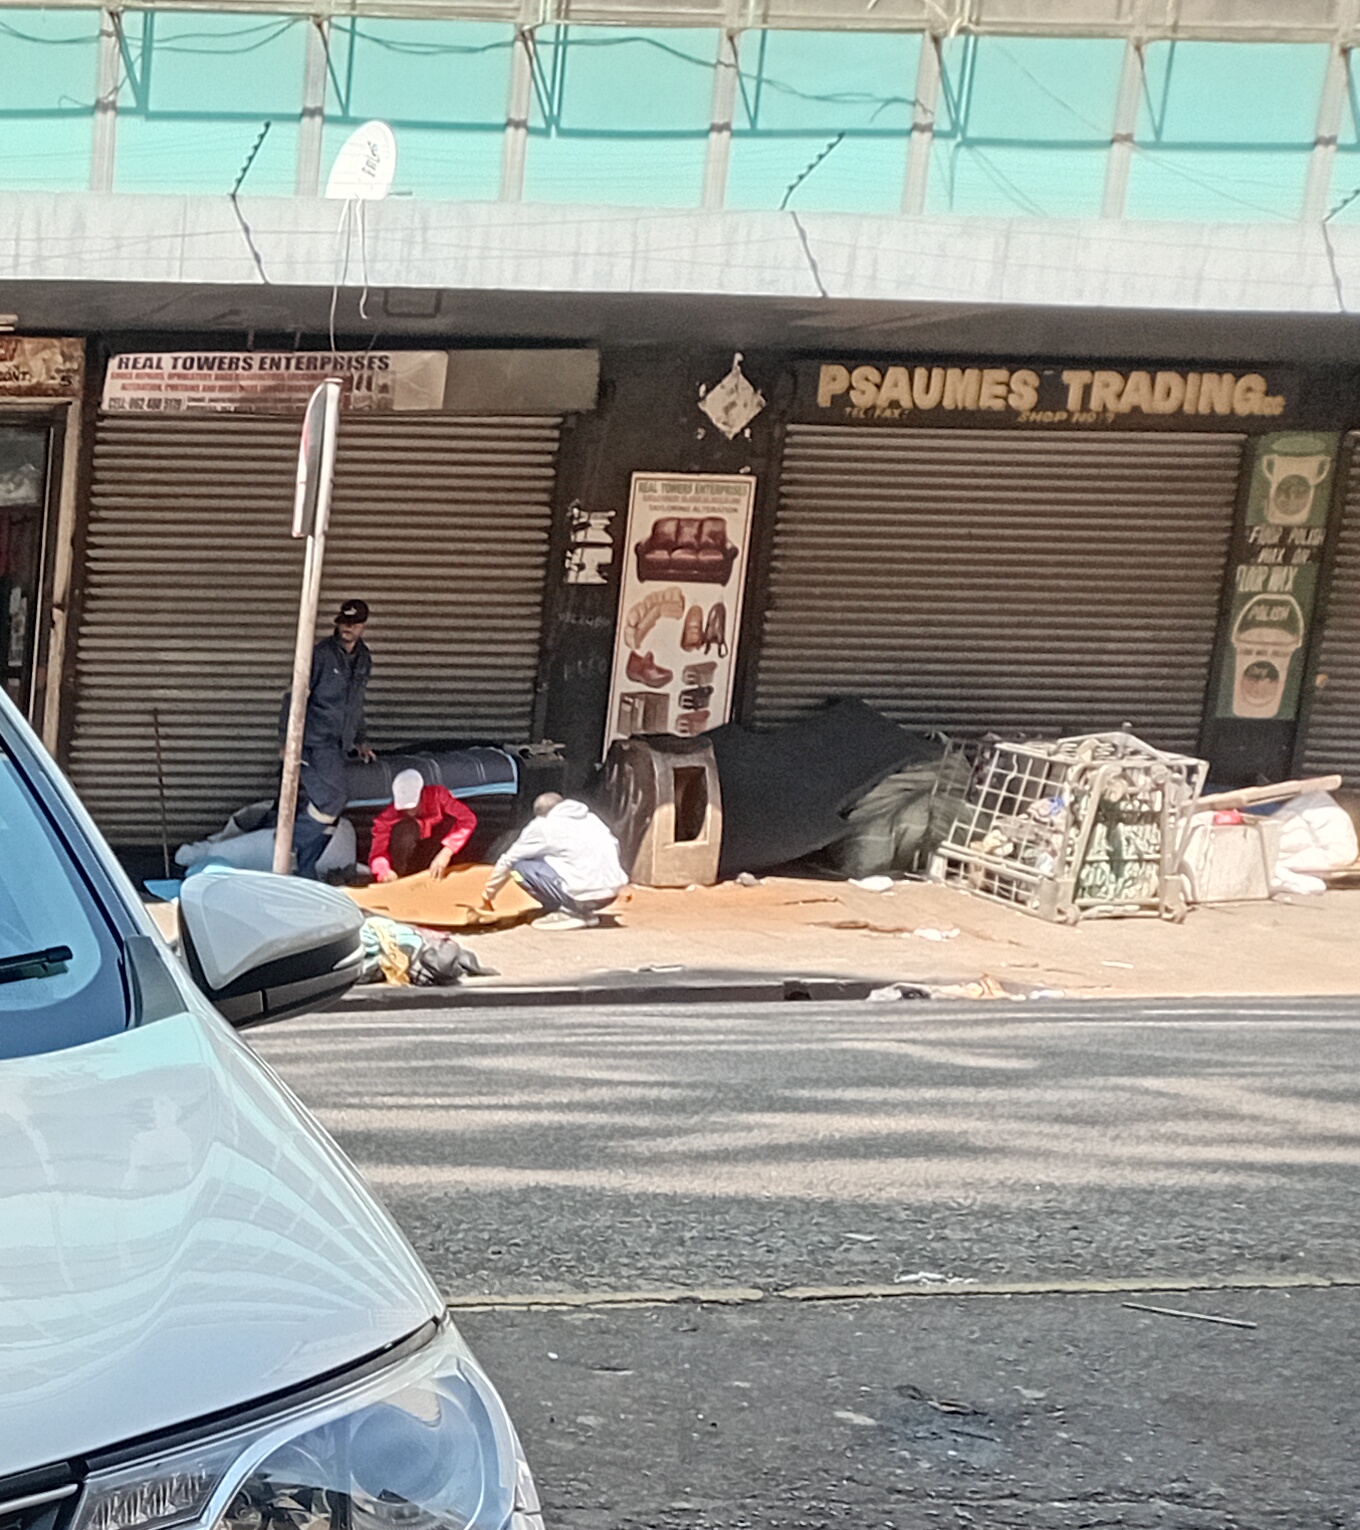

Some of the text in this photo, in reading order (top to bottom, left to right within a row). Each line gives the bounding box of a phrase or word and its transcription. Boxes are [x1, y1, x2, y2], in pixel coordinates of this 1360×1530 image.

[117, 355, 390, 371] REAL TOWERS ENTERPRISES
[818, 364, 1041, 411] PSAUMES
[1062, 369, 1267, 416] TRADING
